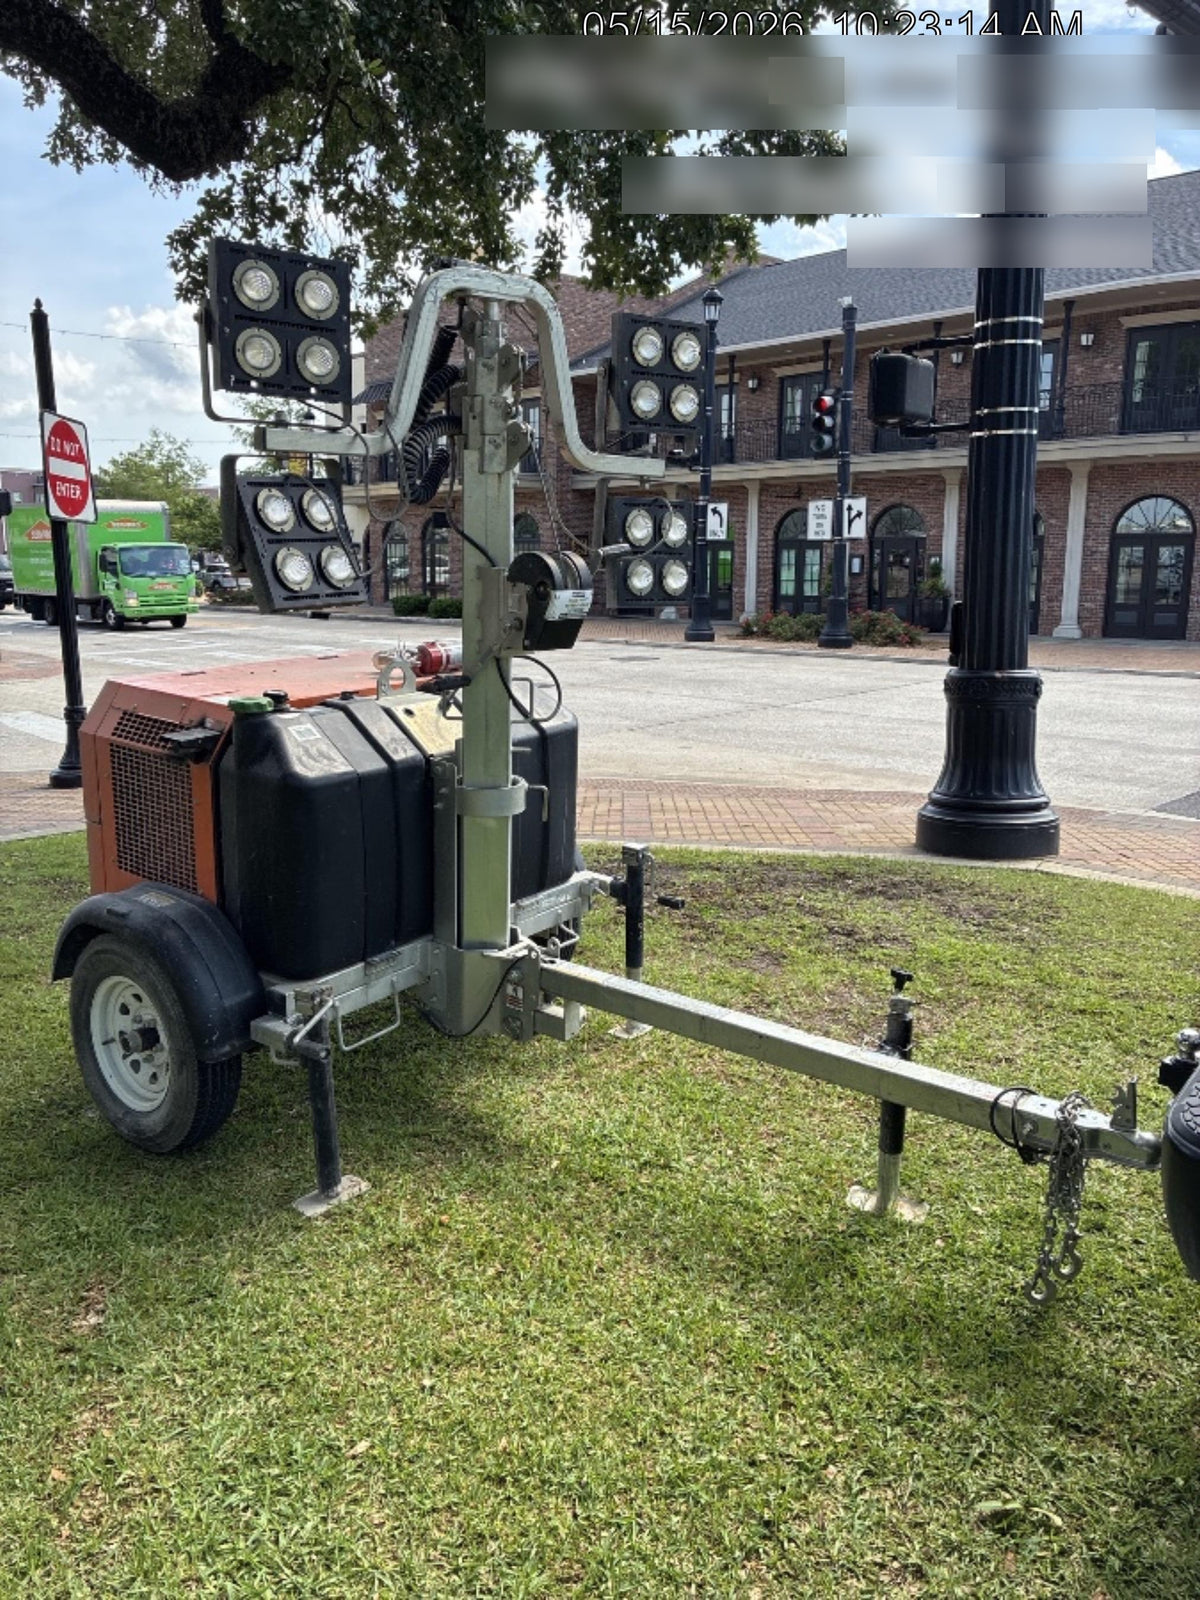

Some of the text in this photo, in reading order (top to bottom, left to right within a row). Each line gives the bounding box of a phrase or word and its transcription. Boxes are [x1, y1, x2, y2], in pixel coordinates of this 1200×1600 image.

[50, 436, 80, 456] DO NOT
[56, 481, 82, 500] ENTER
